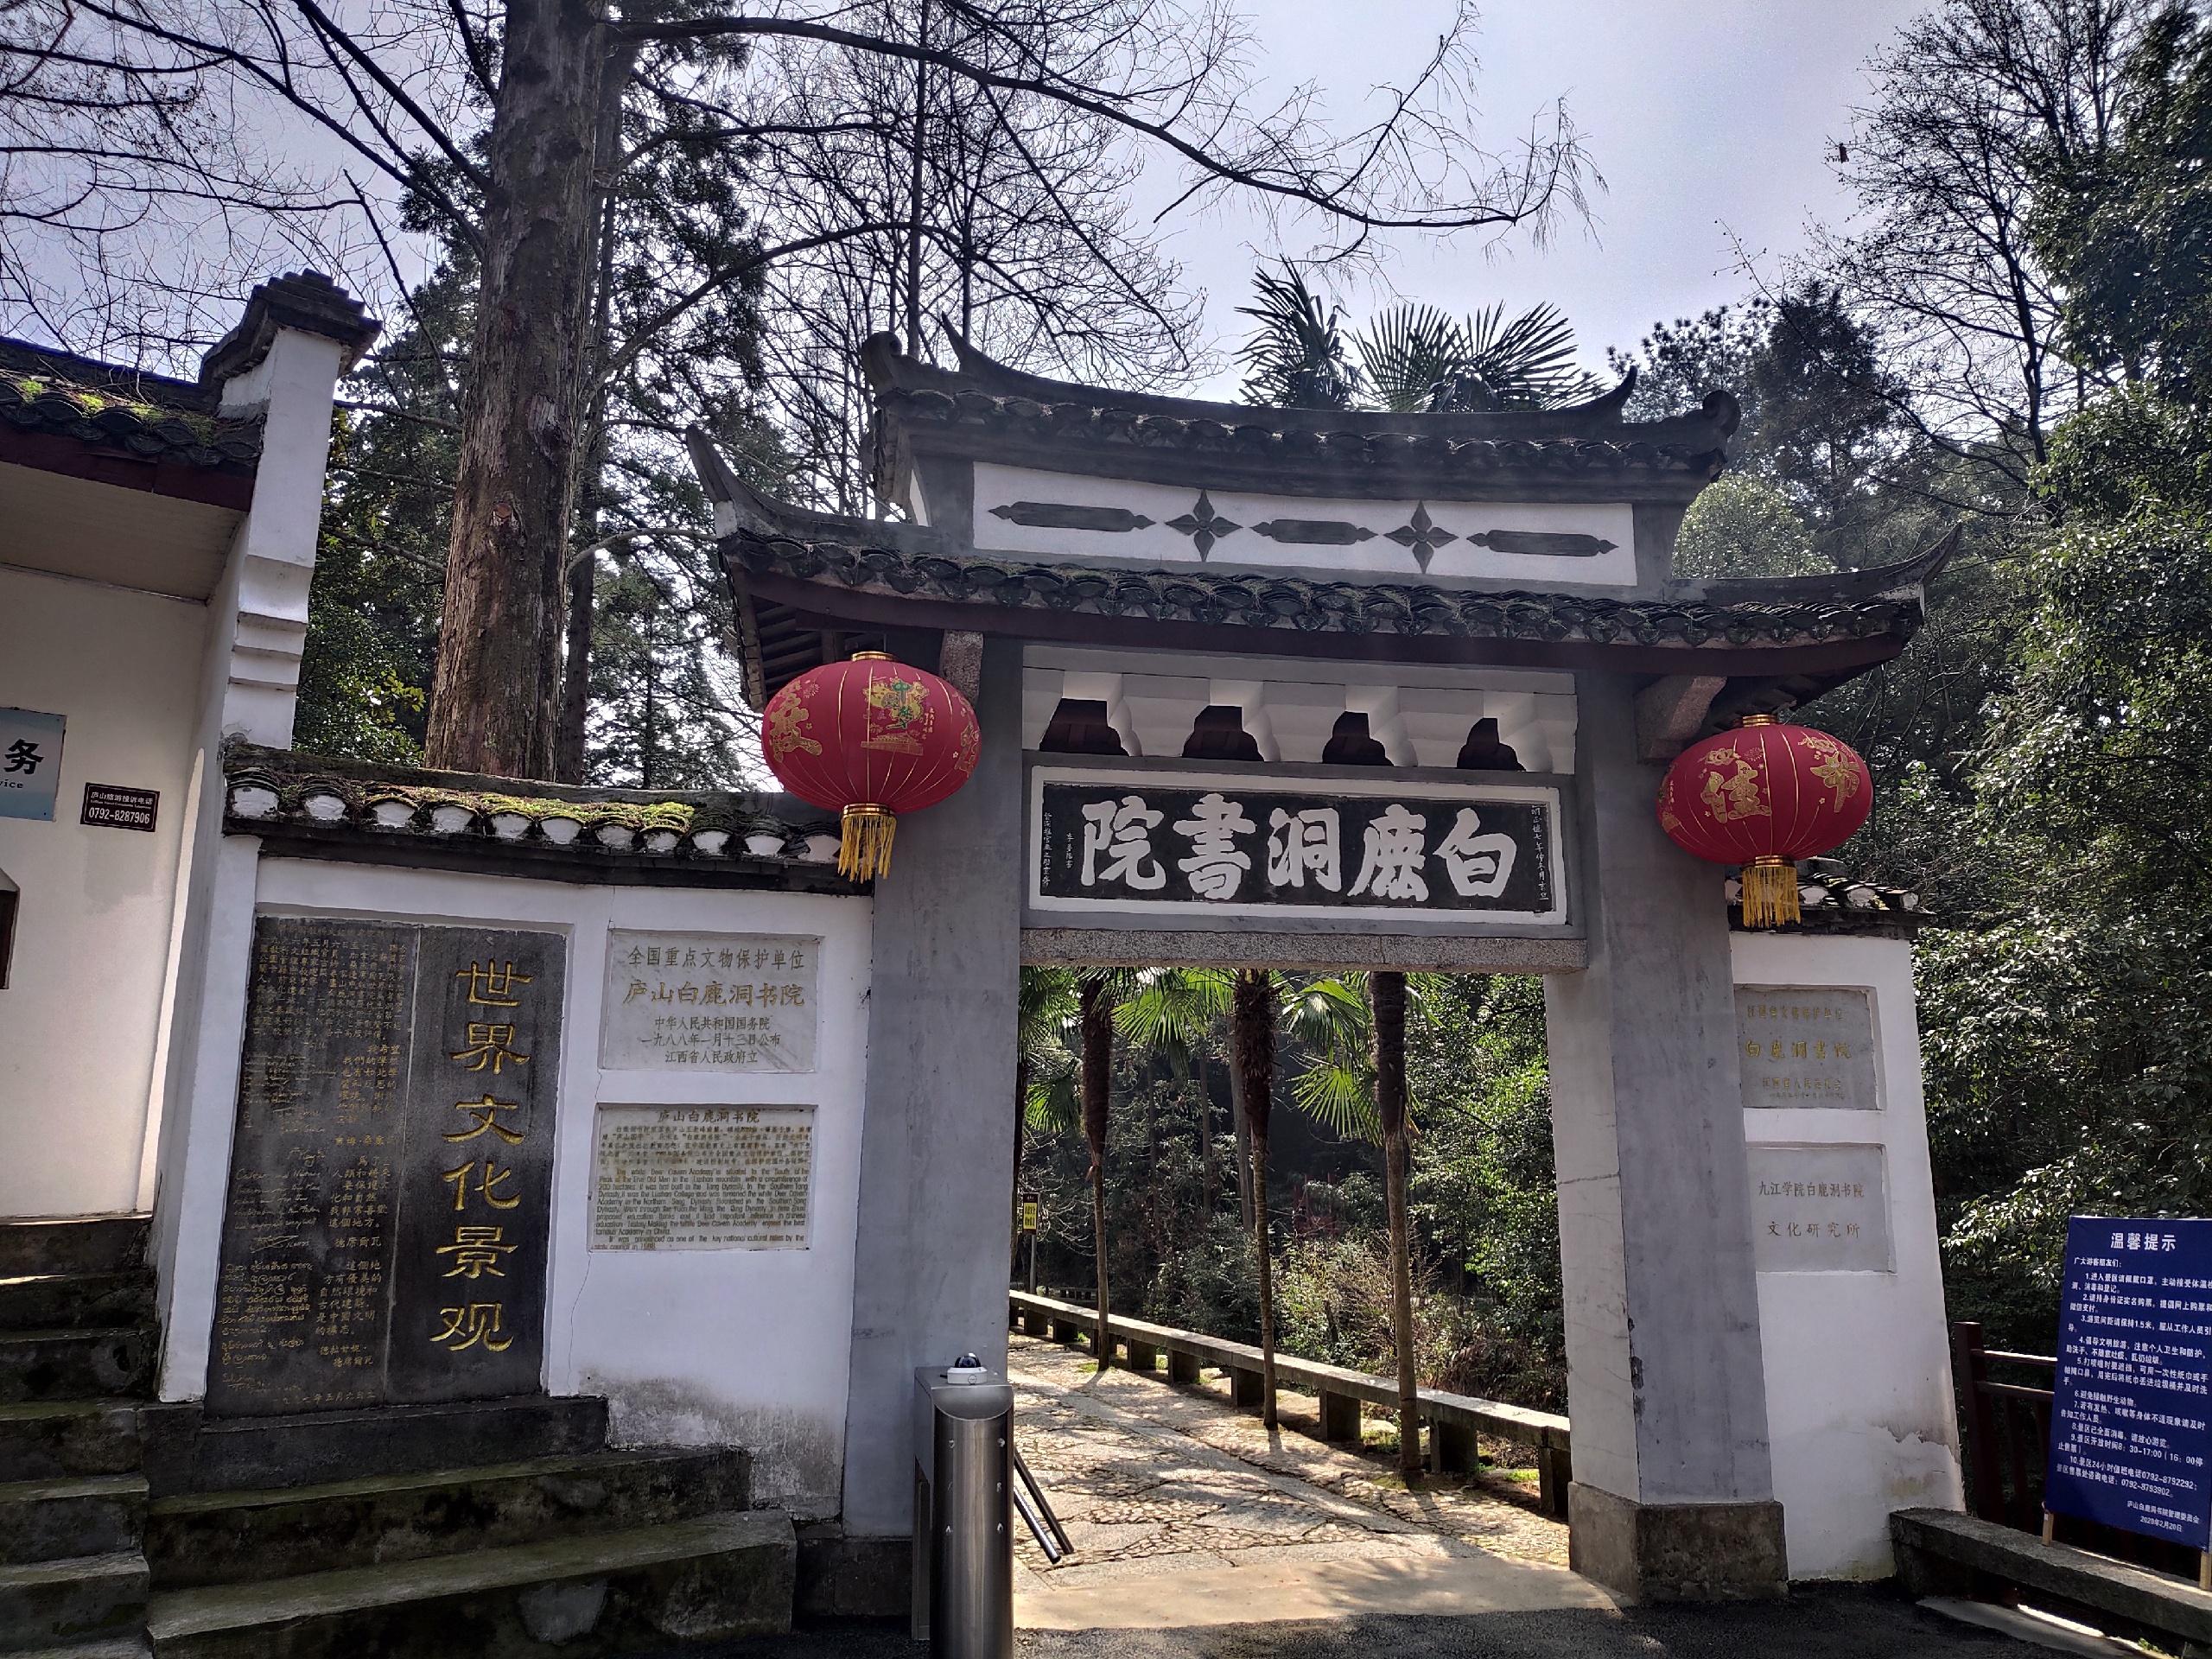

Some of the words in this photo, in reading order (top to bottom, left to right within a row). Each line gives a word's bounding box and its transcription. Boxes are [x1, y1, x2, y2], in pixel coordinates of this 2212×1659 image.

[3, 738, 45, 775] 务
[91, 791, 154, 805] 庐山旅游投诉电话
[89, 806, 150, 824] 0792-8287906
[627, 945, 805, 971] 全国重点文物保护单位
[623, 979, 805, 1008] 庐山白鹿洞书院
[654, 1015, 771, 1031] 中华人民共和国国务院
[641, 1032, 782, 1048] 一九八八年一月十三日公布
[664, 1050, 759, 1065] 江西省人民政府立
[657, 1109, 760, 1123] 庐山白鹿洞书院
[429, 957, 535, 1353] 世界文化景观
[1758, 1180, 1866, 1198] 九江学院白鹿洞书院
[1768, 1220, 1861, 1238] 文化研究所
[2110, 1232, 2177, 1252] 温馨提示
